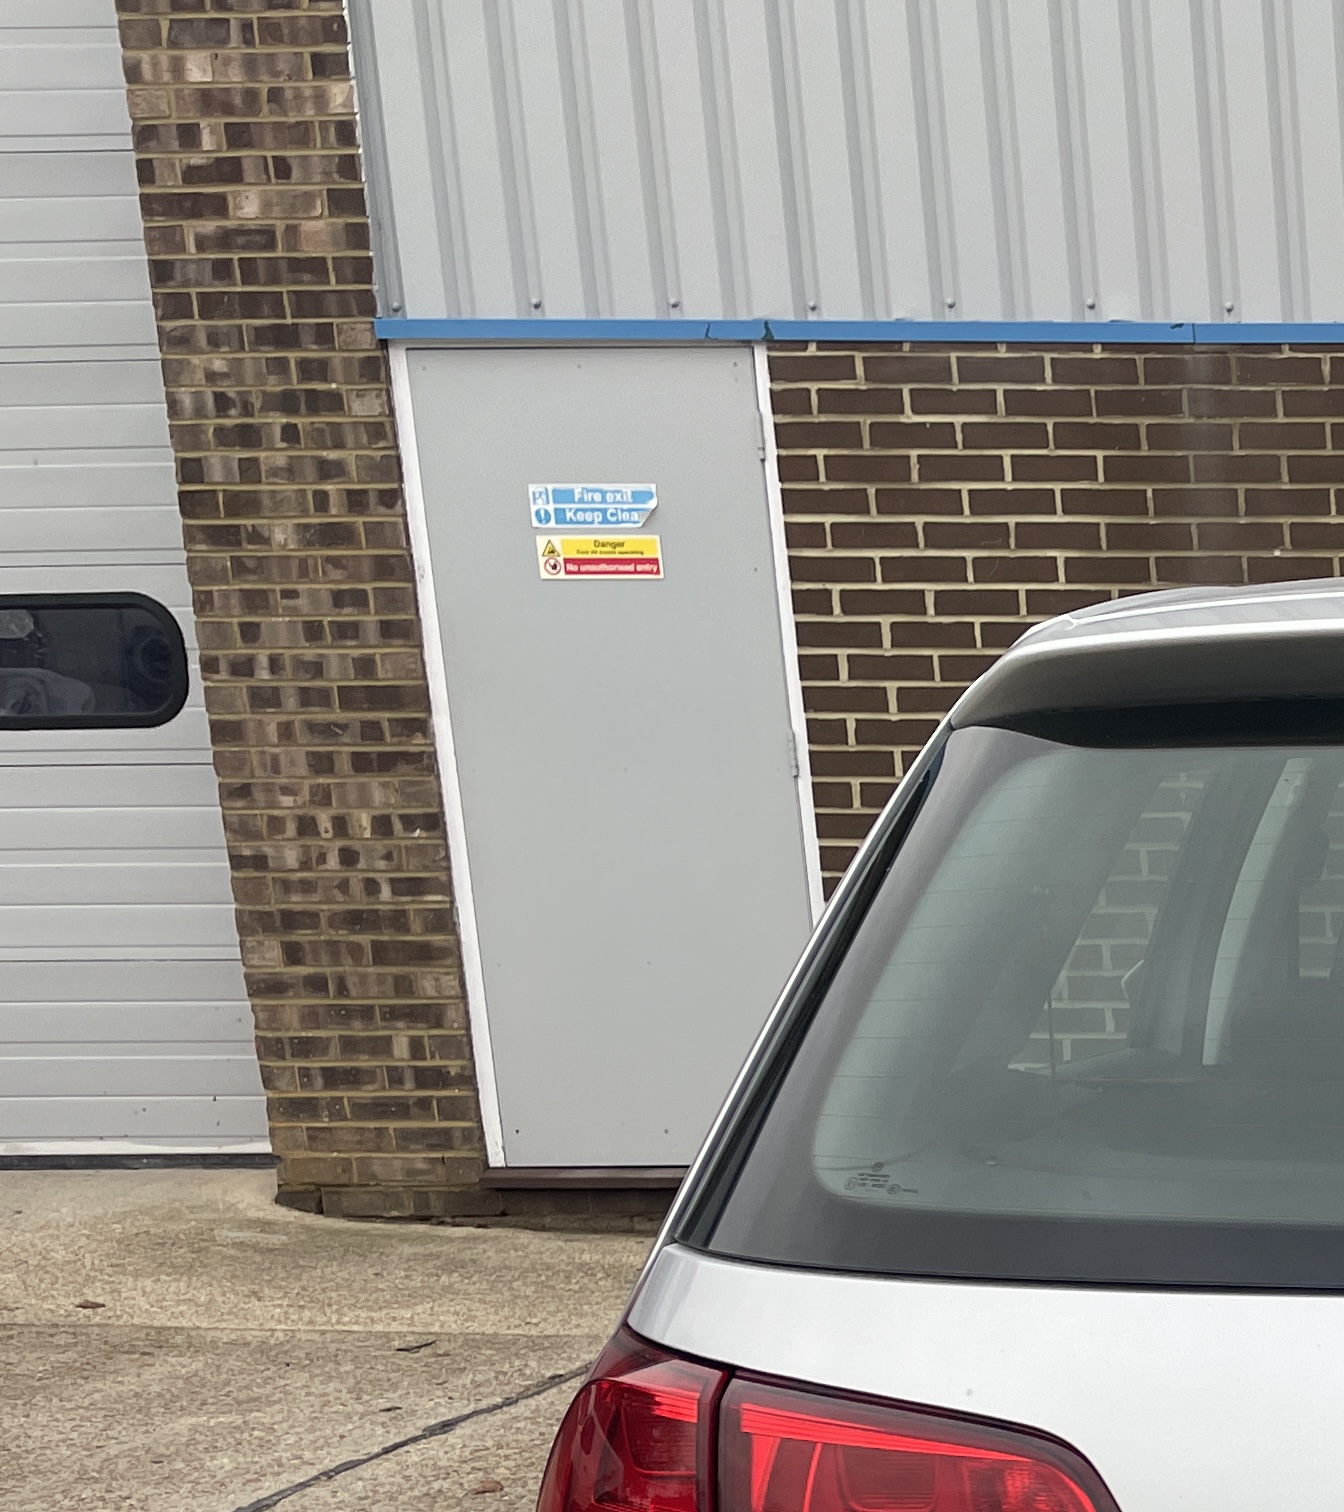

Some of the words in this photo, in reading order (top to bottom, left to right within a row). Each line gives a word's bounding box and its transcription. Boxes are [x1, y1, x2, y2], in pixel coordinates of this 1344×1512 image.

[574, 487, 601, 502] Fire
[605, 488, 633, 503] exit
[566, 508, 602, 525] Keep
[606, 508, 639, 522] Clea
[593, 540, 625, 549] Danger
